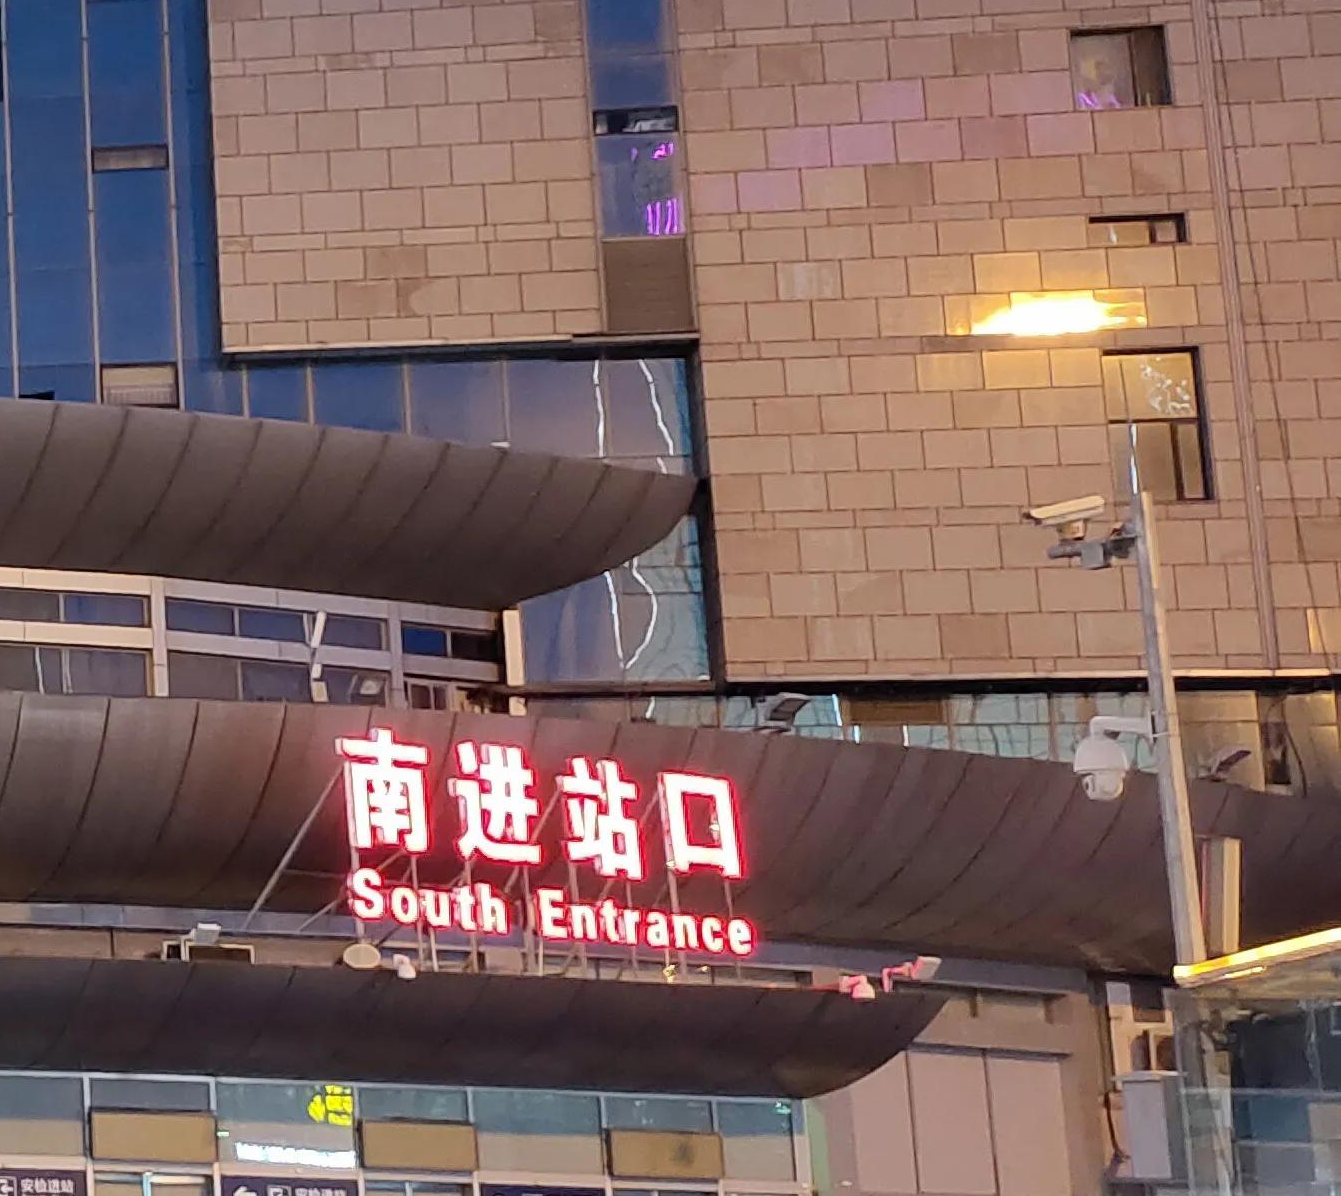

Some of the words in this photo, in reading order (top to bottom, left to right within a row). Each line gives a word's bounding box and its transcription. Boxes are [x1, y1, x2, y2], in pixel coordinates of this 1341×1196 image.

[336, 728, 743, 880] 南进站口
[350, 868, 509, 935] South
[537, 888, 754, 956] Entrance
